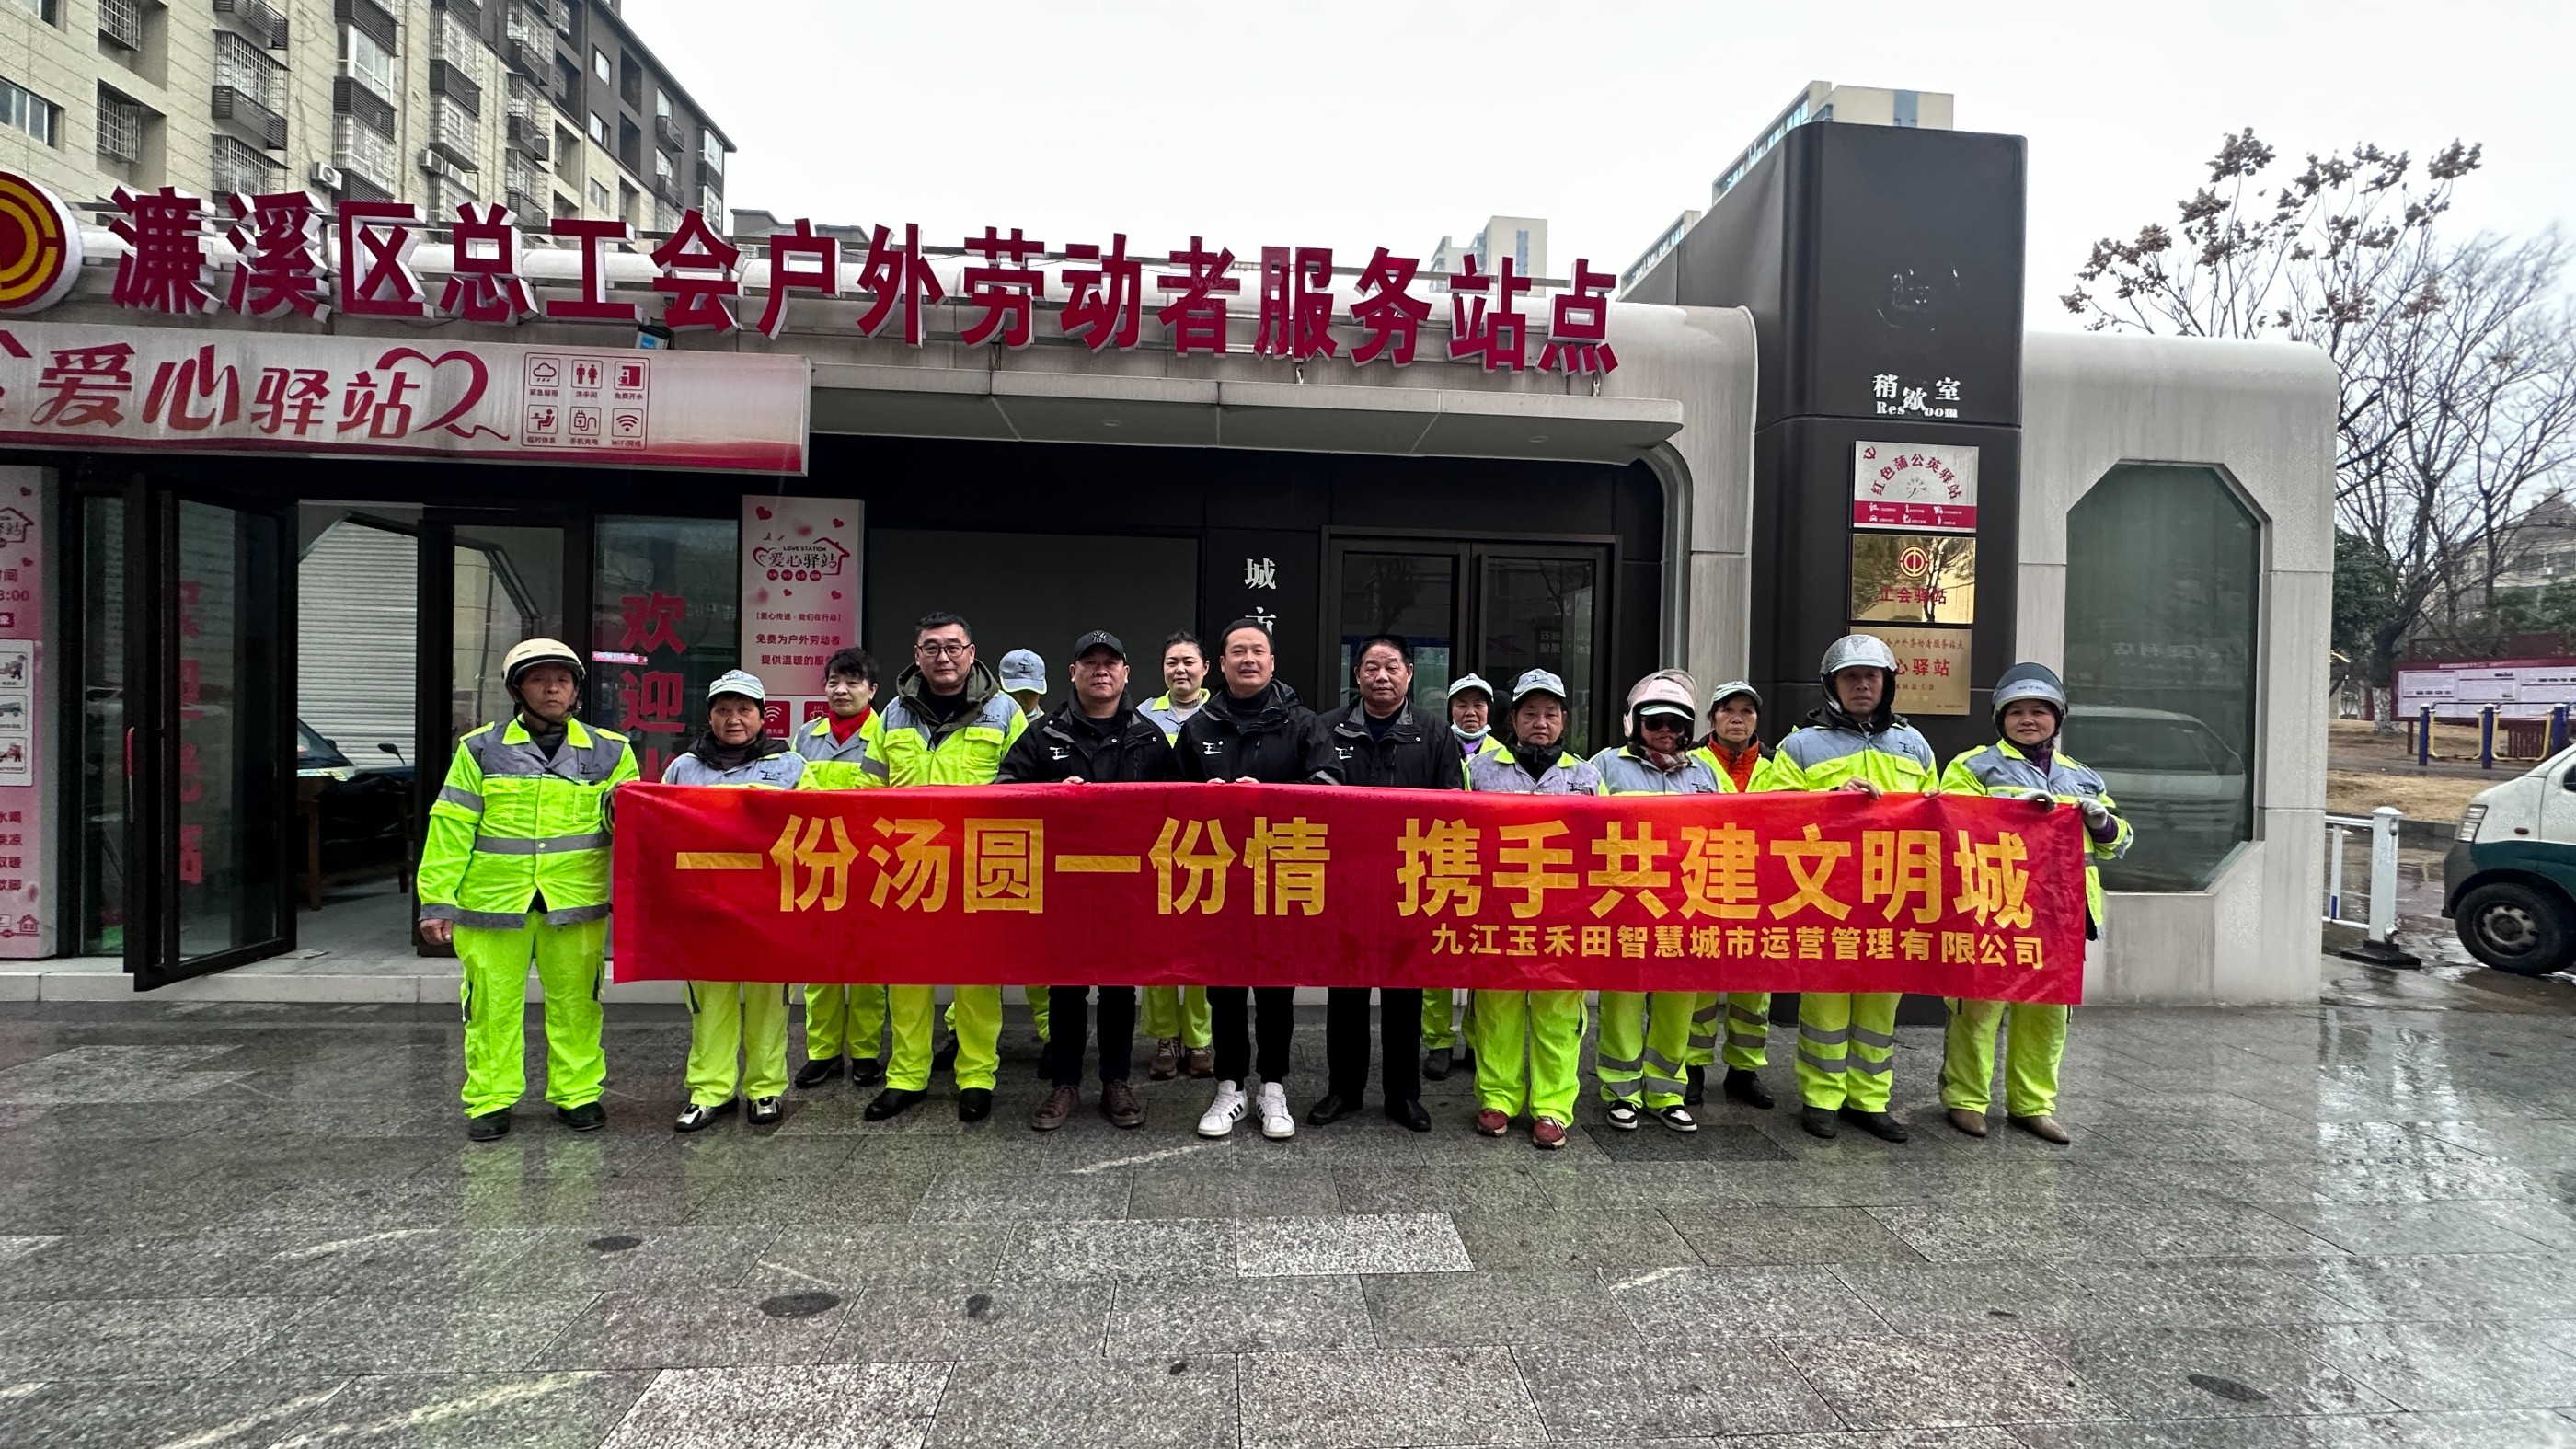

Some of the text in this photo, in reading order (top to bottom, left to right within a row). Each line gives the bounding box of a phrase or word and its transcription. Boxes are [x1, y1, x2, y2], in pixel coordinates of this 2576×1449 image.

[109, 185, 1619, 374] 濂溪区总工会户外劳动者服务站点
[31, 342, 420, 439] 爱心驿站
[1870, 453, 1962, 500] 红色蒲公英驿站
[769, 552, 837, 569] 爱心驿站
[1880, 586, 1948, 604] 工会驿站
[756, 633, 841, 646] 免费为户外劳动者
[675, 815, 2033, 930] 一份汤圆一份情 携手共建文明城
[1432, 924, 2043, 970] 九江玉禾田智慧城市运营管理有限公司
